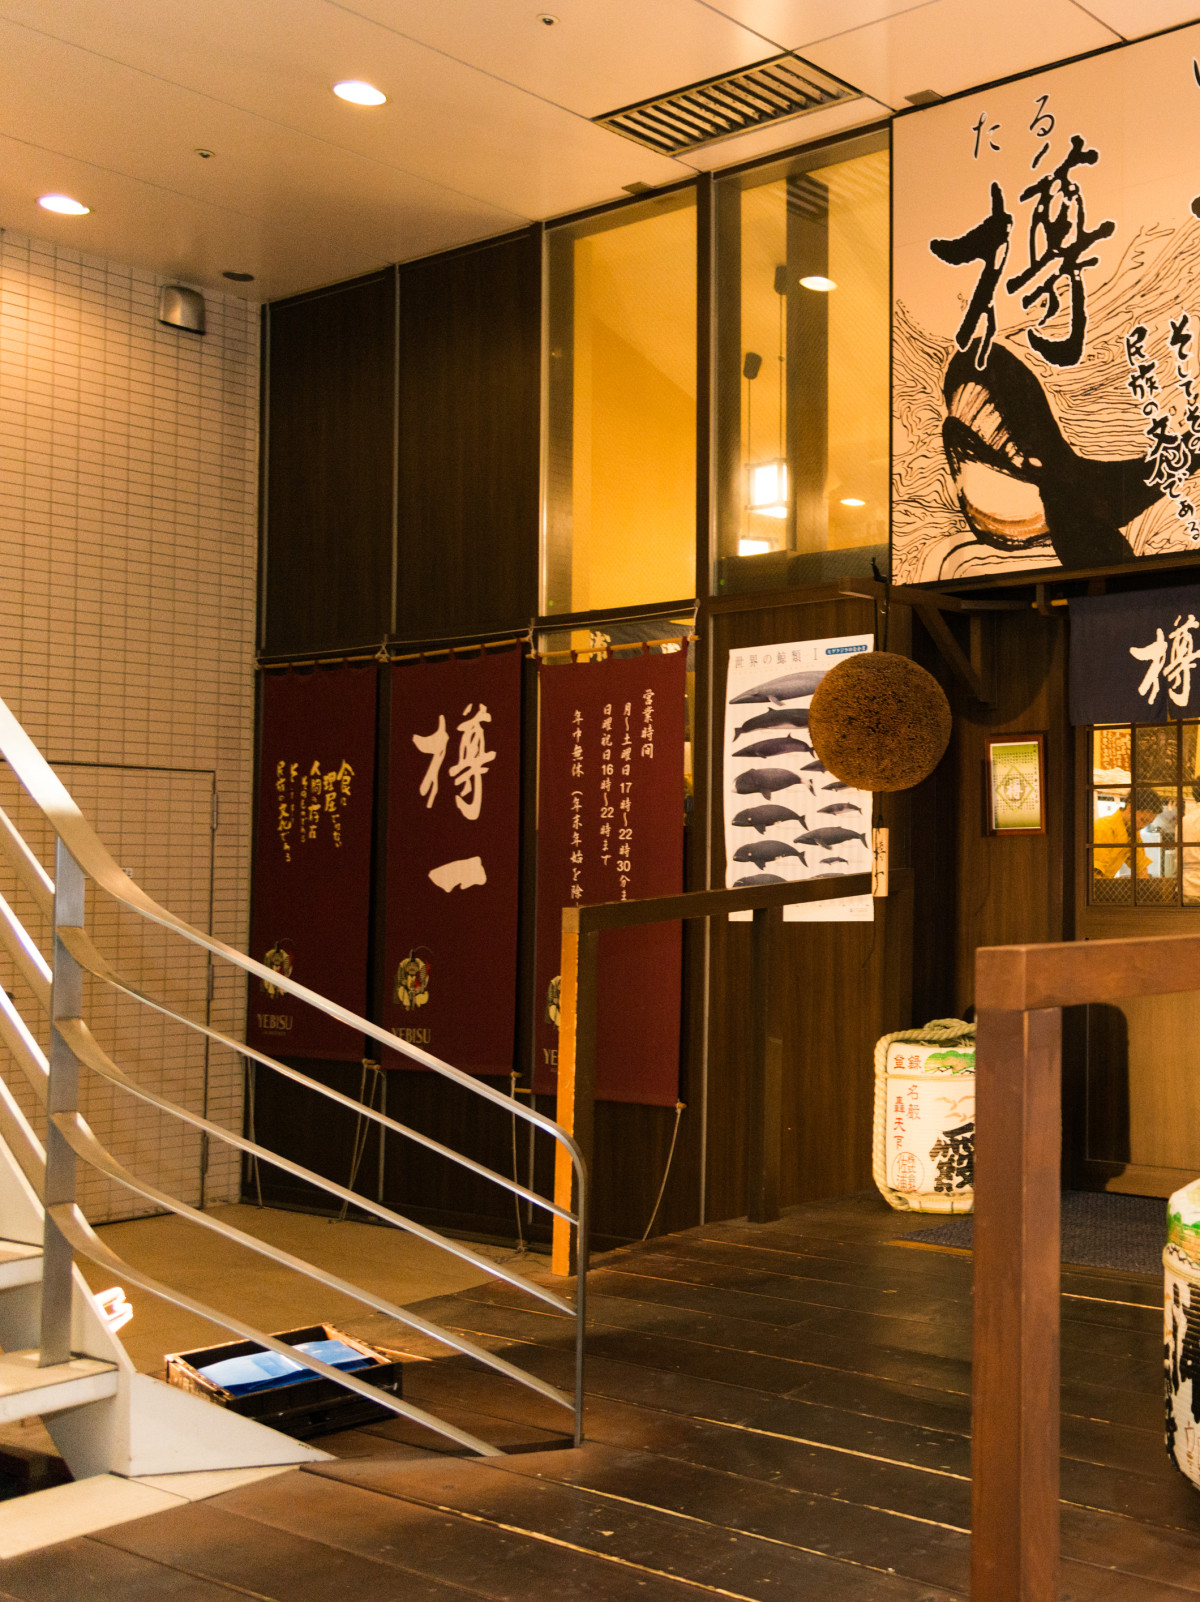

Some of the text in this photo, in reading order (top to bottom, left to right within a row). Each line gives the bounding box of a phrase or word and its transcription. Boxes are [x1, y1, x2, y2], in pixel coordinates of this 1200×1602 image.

[972, 94, 1056, 160] たる
[641, 689, 655, 758] 営業時間
[257, 1014, 294, 1030] YEBISU
